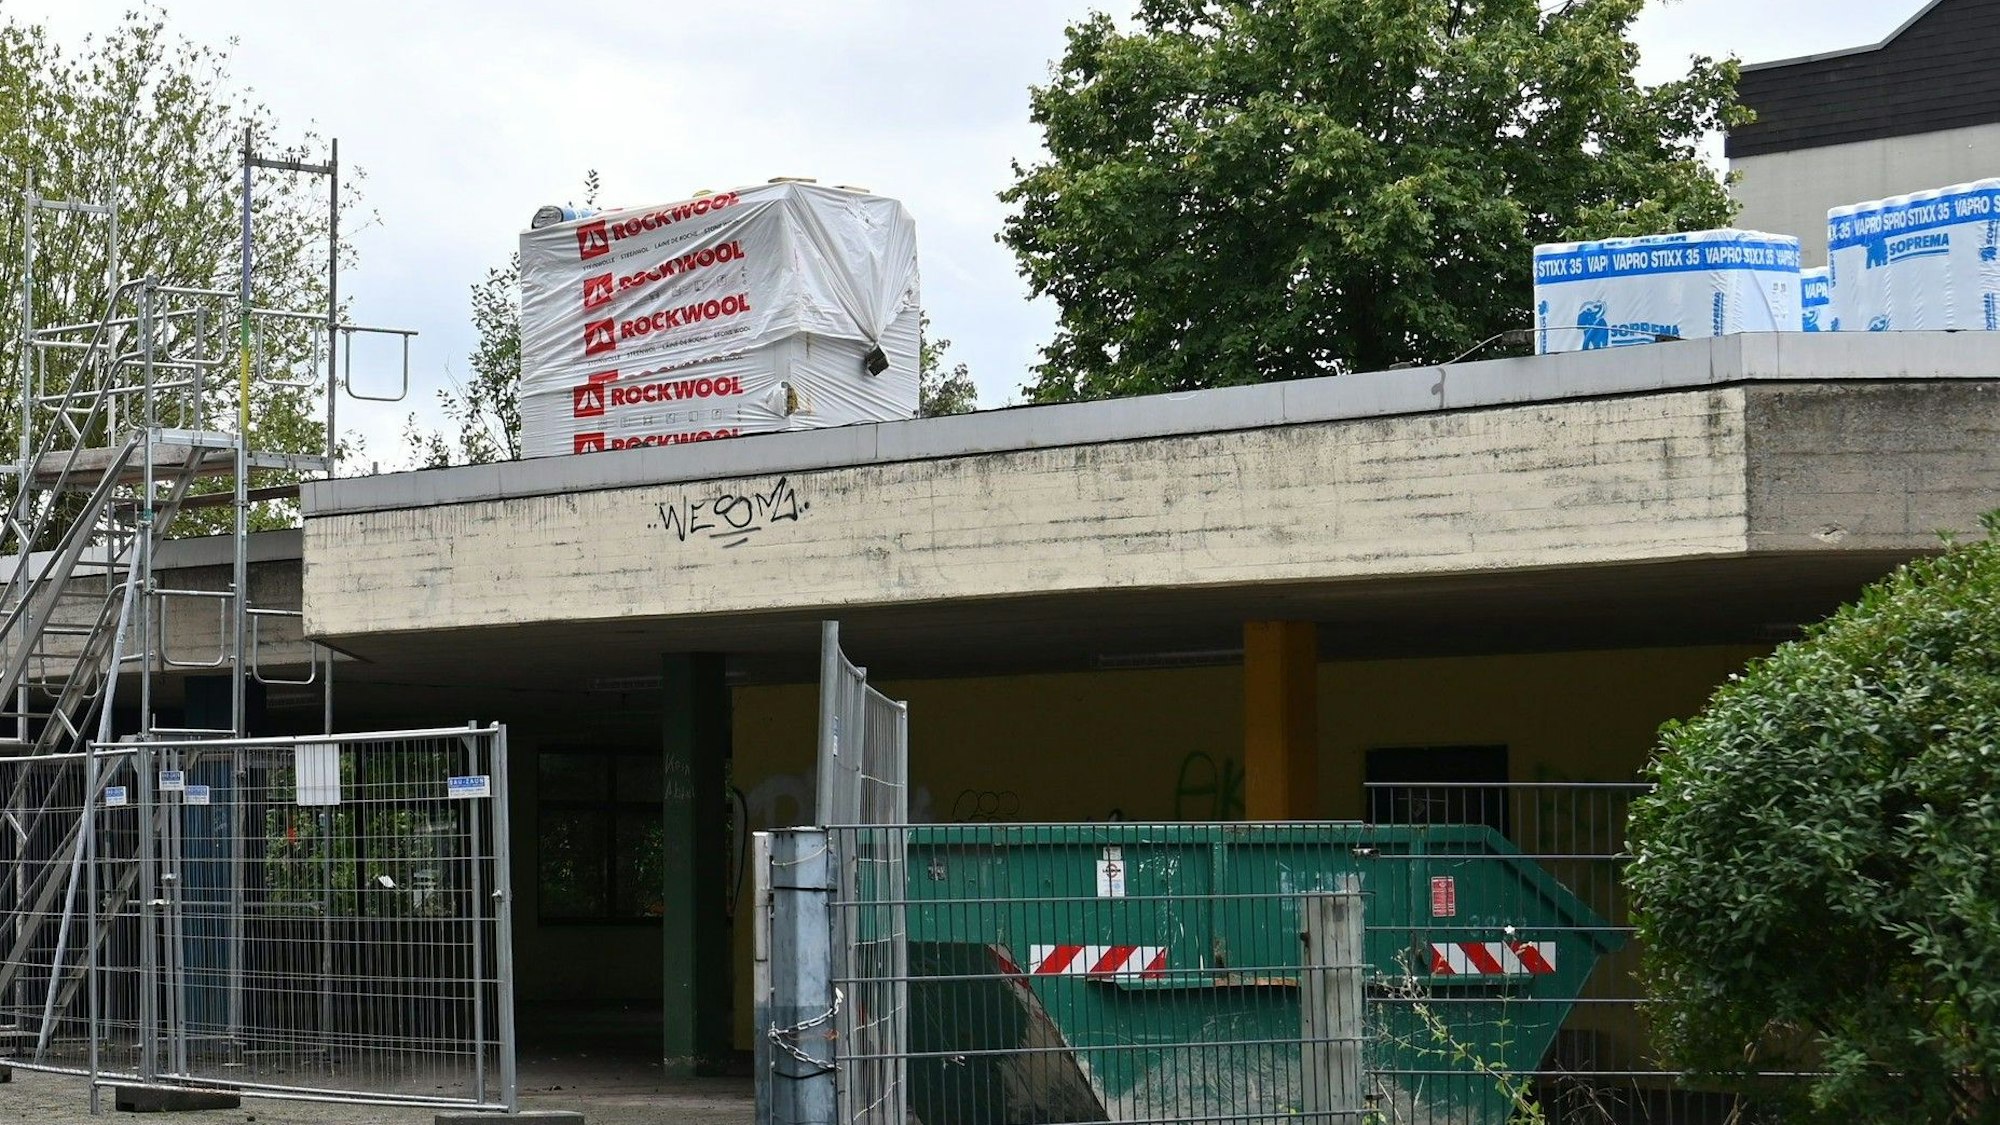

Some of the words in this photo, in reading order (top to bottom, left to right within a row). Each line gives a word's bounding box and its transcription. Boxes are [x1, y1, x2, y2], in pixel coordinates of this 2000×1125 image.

[611, 191, 740, 241] ROCKWOOL
[1854, 215, 1881, 235] VAPRO
[1908, 206, 1936, 226] STIXX
[1937, 202, 1949, 220] 35
[1955, 196, 1989, 218] VAPRO
[671, 236, 680, 246] DE
[1889, 233, 1949, 256] SOPREMA
[619, 239, 745, 290] ROCKWOOL
[1538, 258, 1567, 278] STIXX
[1569, 257, 1582, 275] 35
[1613, 251, 1648, 271] VAPRO
[1651, 249, 1683, 268] STIXX
[1686, 249, 1699, 265] 35
[1705, 247, 1742, 264] VAPRO
[620, 293, 750, 339] ROCKWOOL
[1610, 322, 1680, 337] SOPREMA
[611, 376, 743, 407] ROCKWOOL
